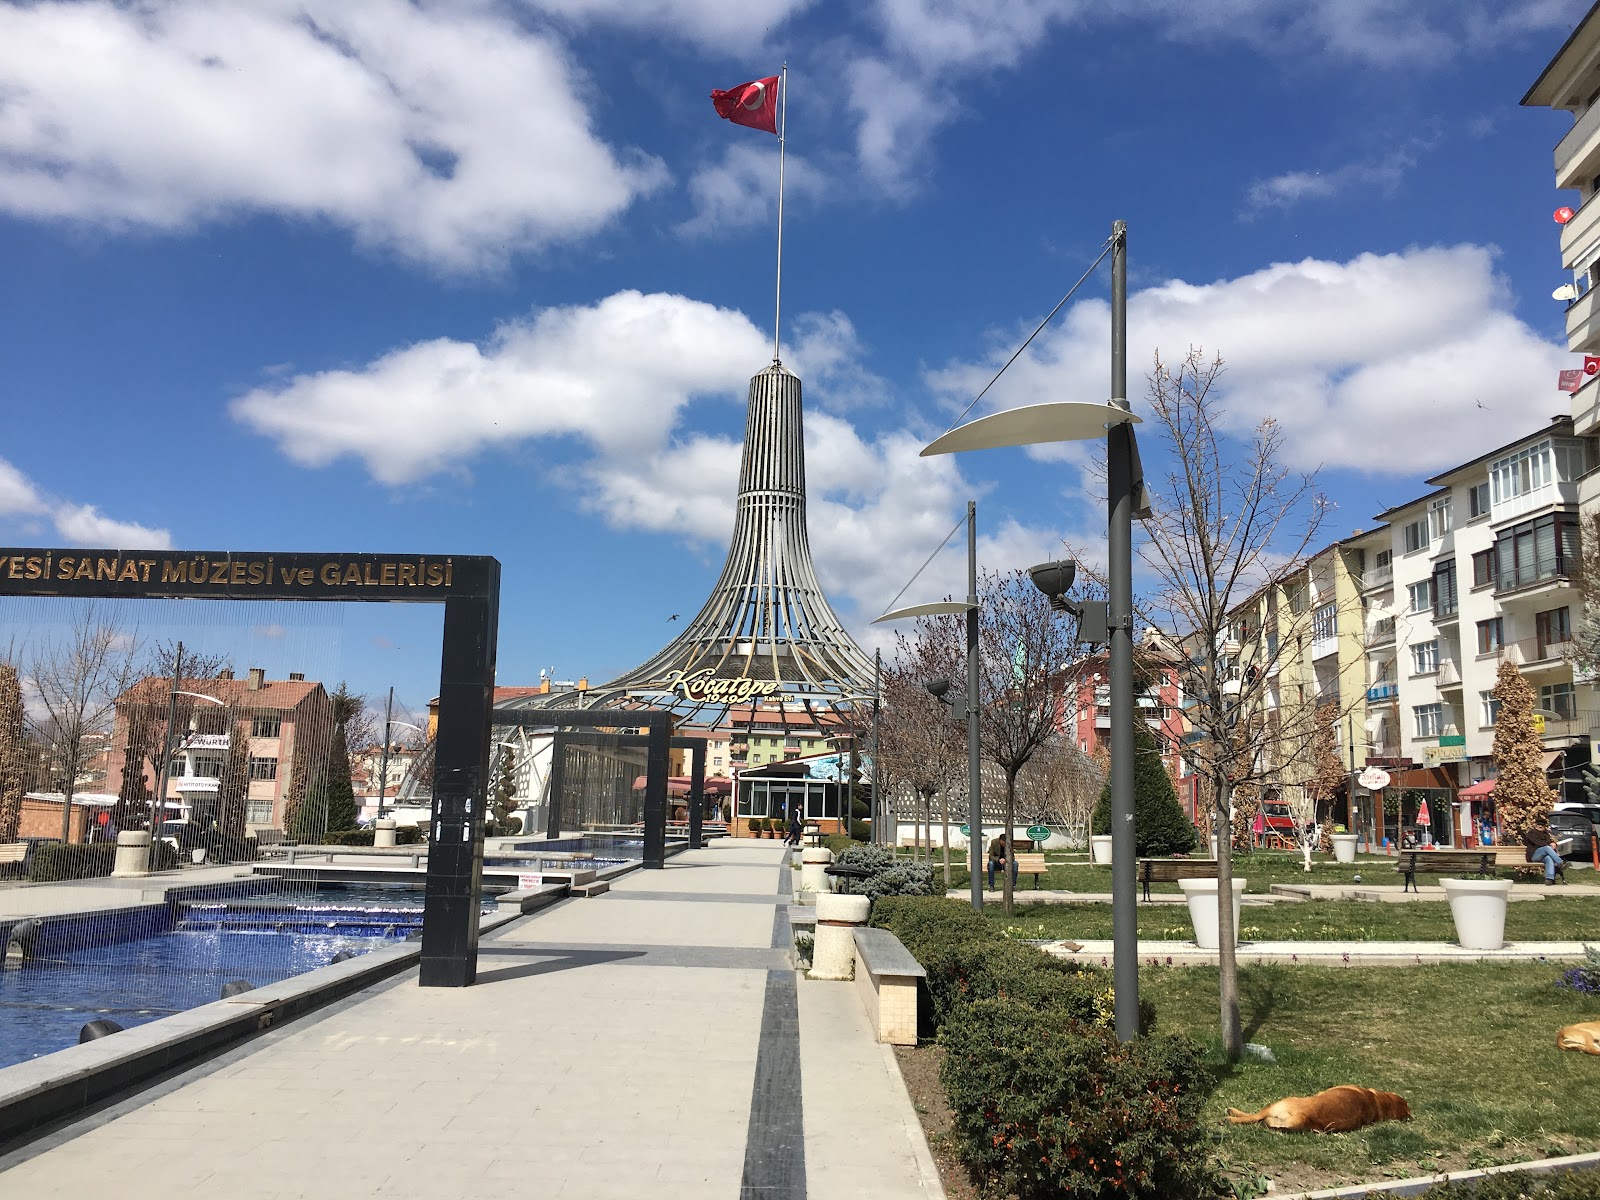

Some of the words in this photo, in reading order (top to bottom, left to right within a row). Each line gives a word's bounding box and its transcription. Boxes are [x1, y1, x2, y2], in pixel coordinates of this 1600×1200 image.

[56, 556, 156, 582] SANAT
[161, 555, 274, 586] MÜZESİ
[280, 567, 314, 586] ve
[320, 557, 453, 587] GALERİSİ
[666, 668, 779, 703] Kocatepe
[705, 694, 738, 704] 1949
